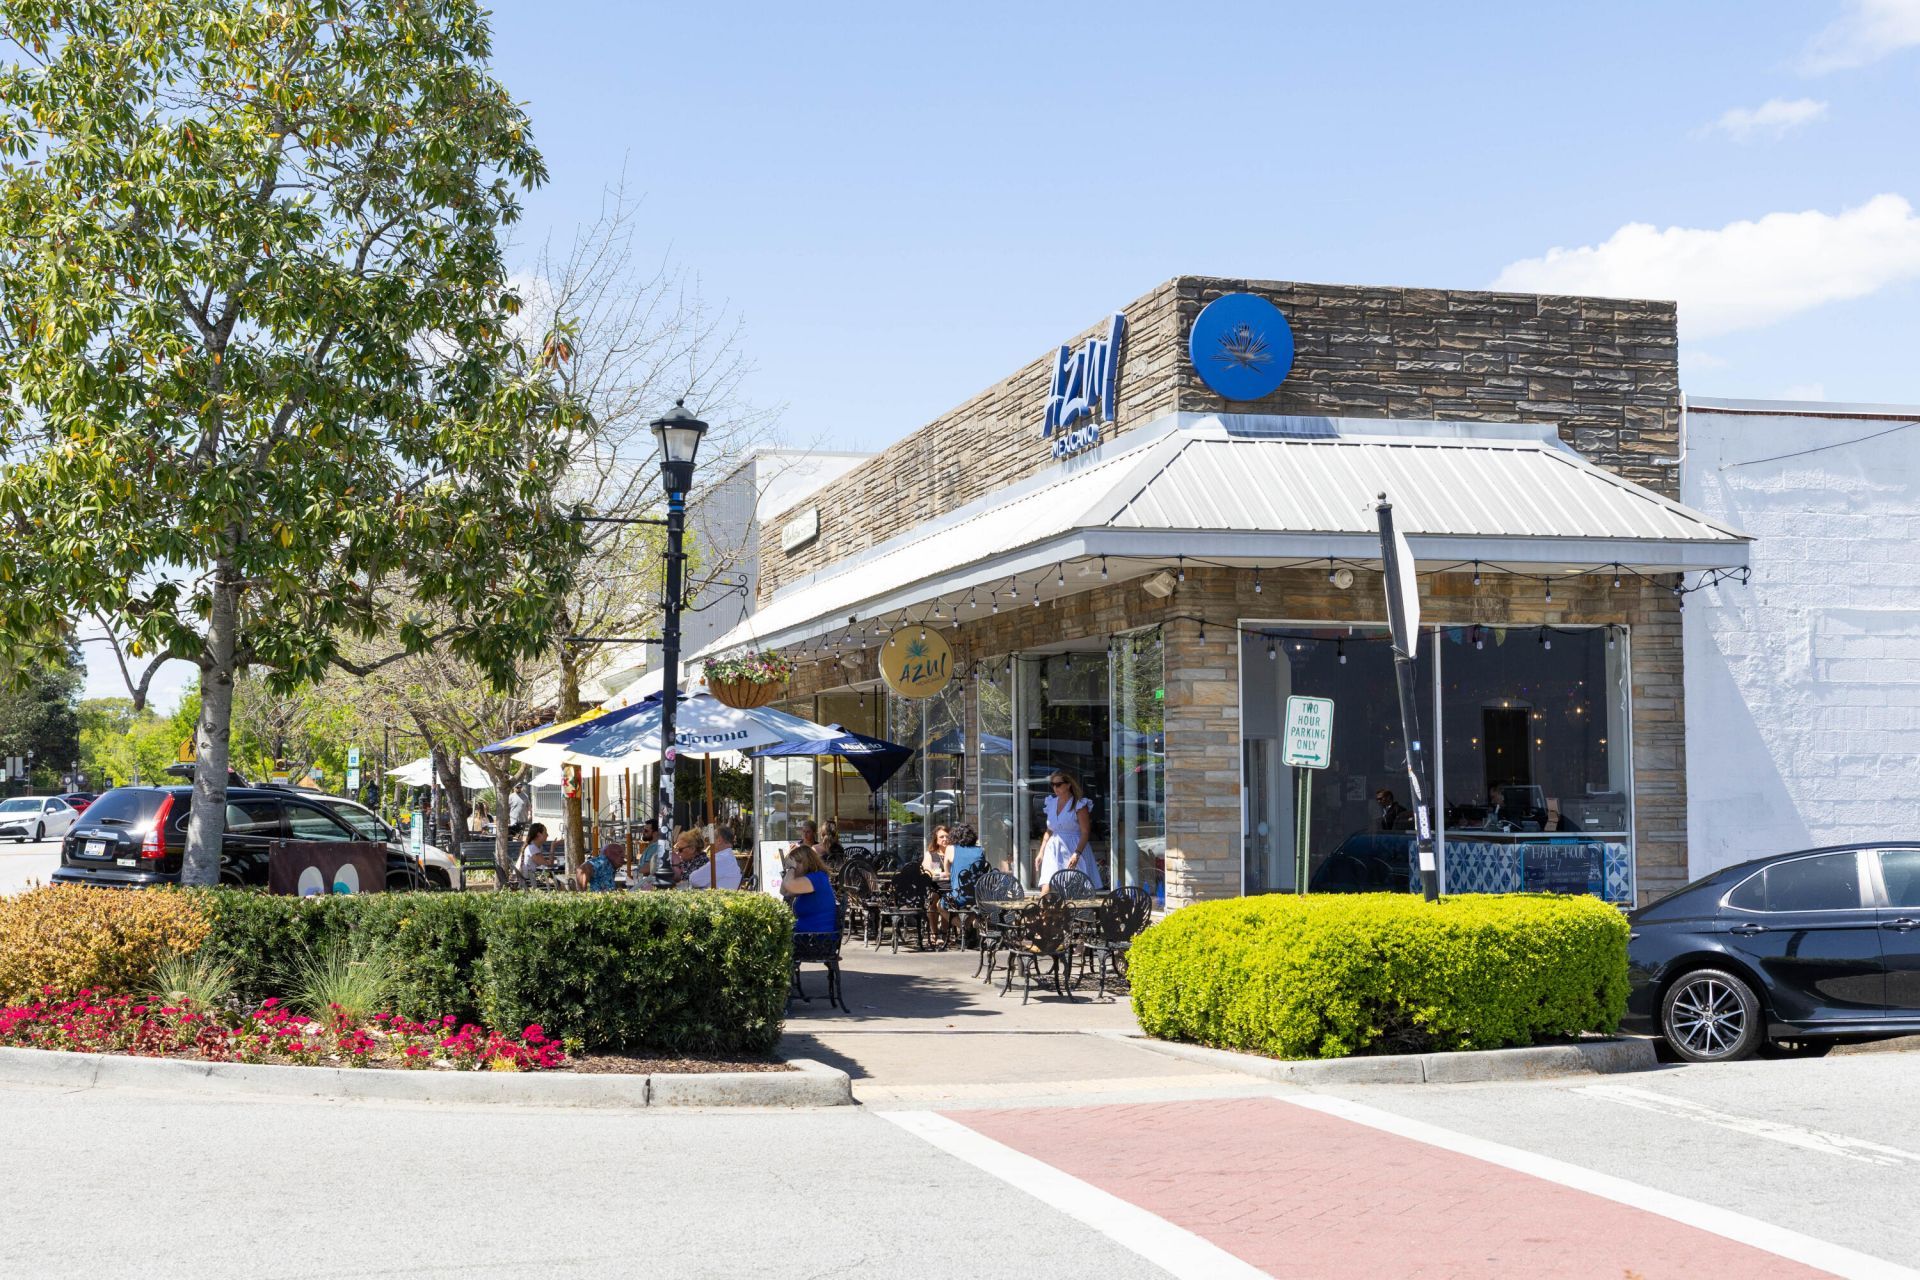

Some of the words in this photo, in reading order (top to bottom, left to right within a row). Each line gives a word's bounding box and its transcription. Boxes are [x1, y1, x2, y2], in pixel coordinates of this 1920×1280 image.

[1051, 423, 1100, 459] MEXICANO
[1302, 702, 1319, 714] TWO
[1297, 715, 1321, 727] HOUR
[675, 730, 749, 747] Corona
[1290, 726, 1326, 740] PARKING
[838, 742, 883, 751] Modelo
[1296, 739, 1318, 751] ONLY
